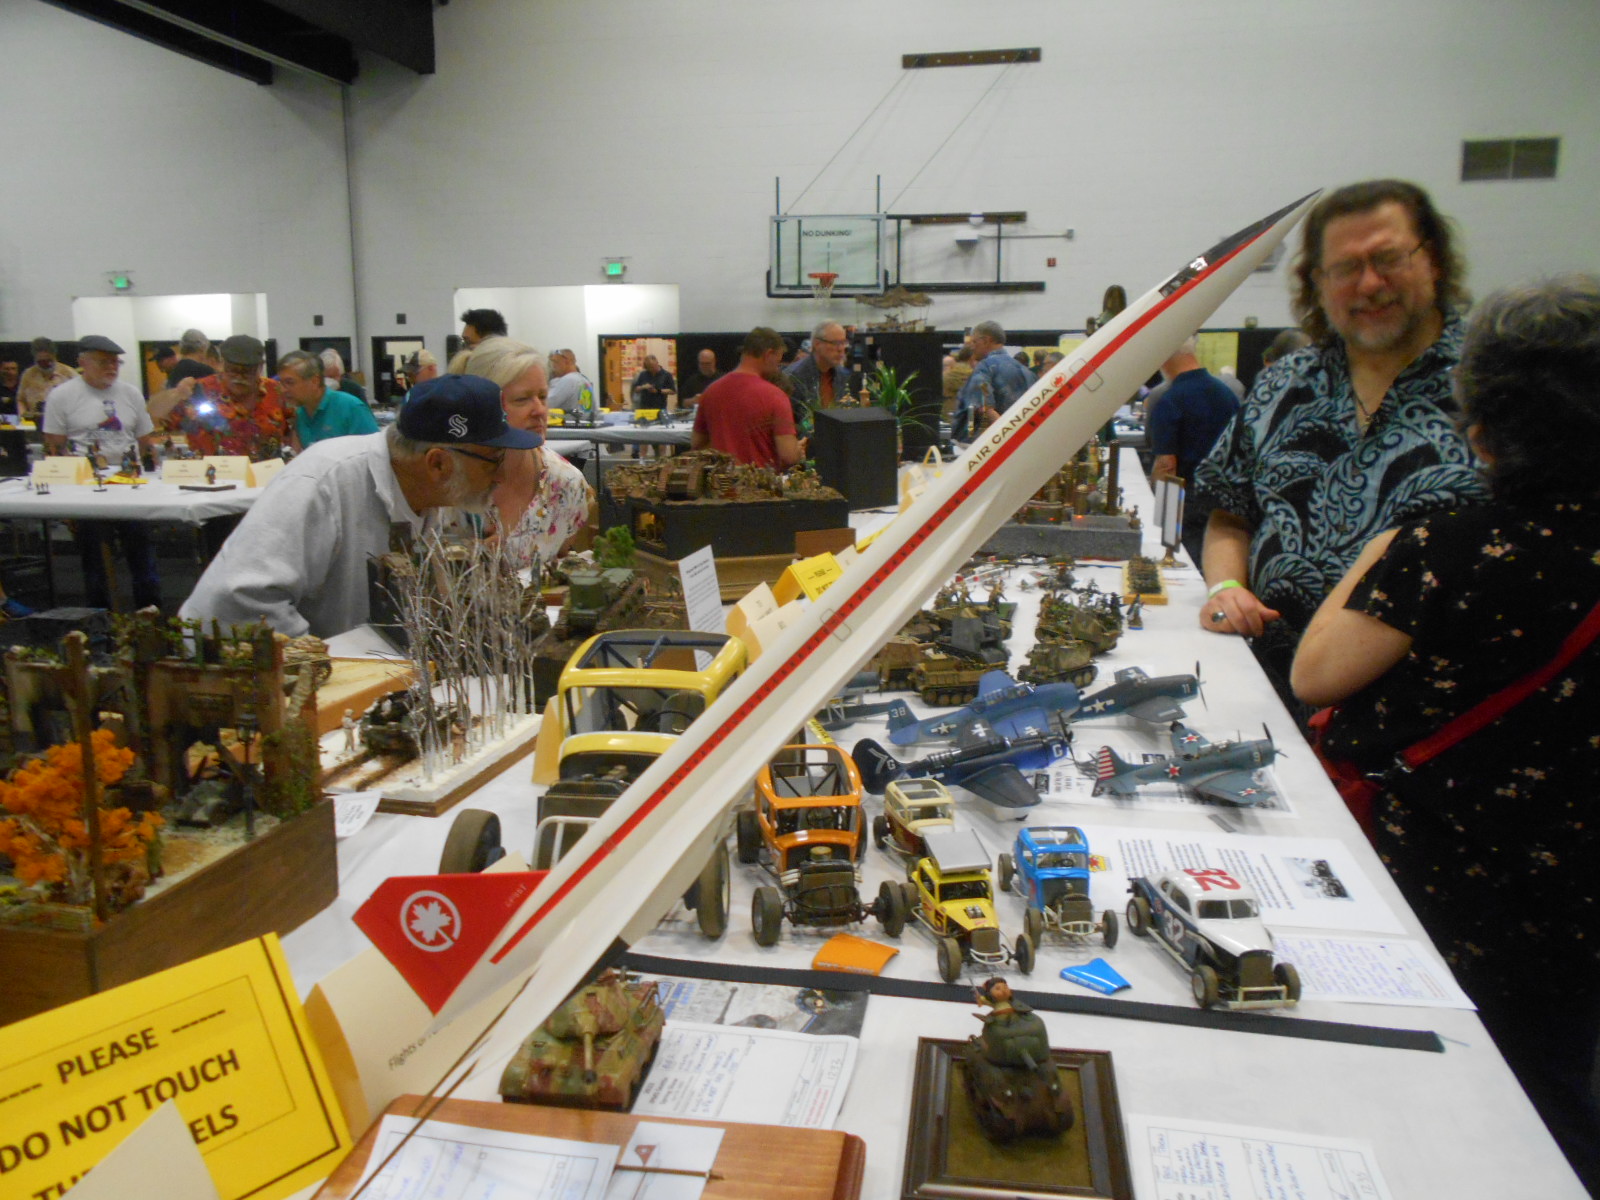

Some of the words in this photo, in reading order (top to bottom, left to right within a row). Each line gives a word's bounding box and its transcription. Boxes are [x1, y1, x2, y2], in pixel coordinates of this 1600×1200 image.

[448, 413, 468, 438] S
[967, 445, 992, 472] AIR
[991, 387, 1053, 445] CANADA
[1183, 868, 1241, 891] 32
[56, 1027, 160, 1085] PLEASE
[0, 1131, 50, 1176] DO
[58, 1095, 127, 1146] NOT
[133, 1048, 241, 1111] TOUCH
[188, 1104, 239, 1146] ELS
